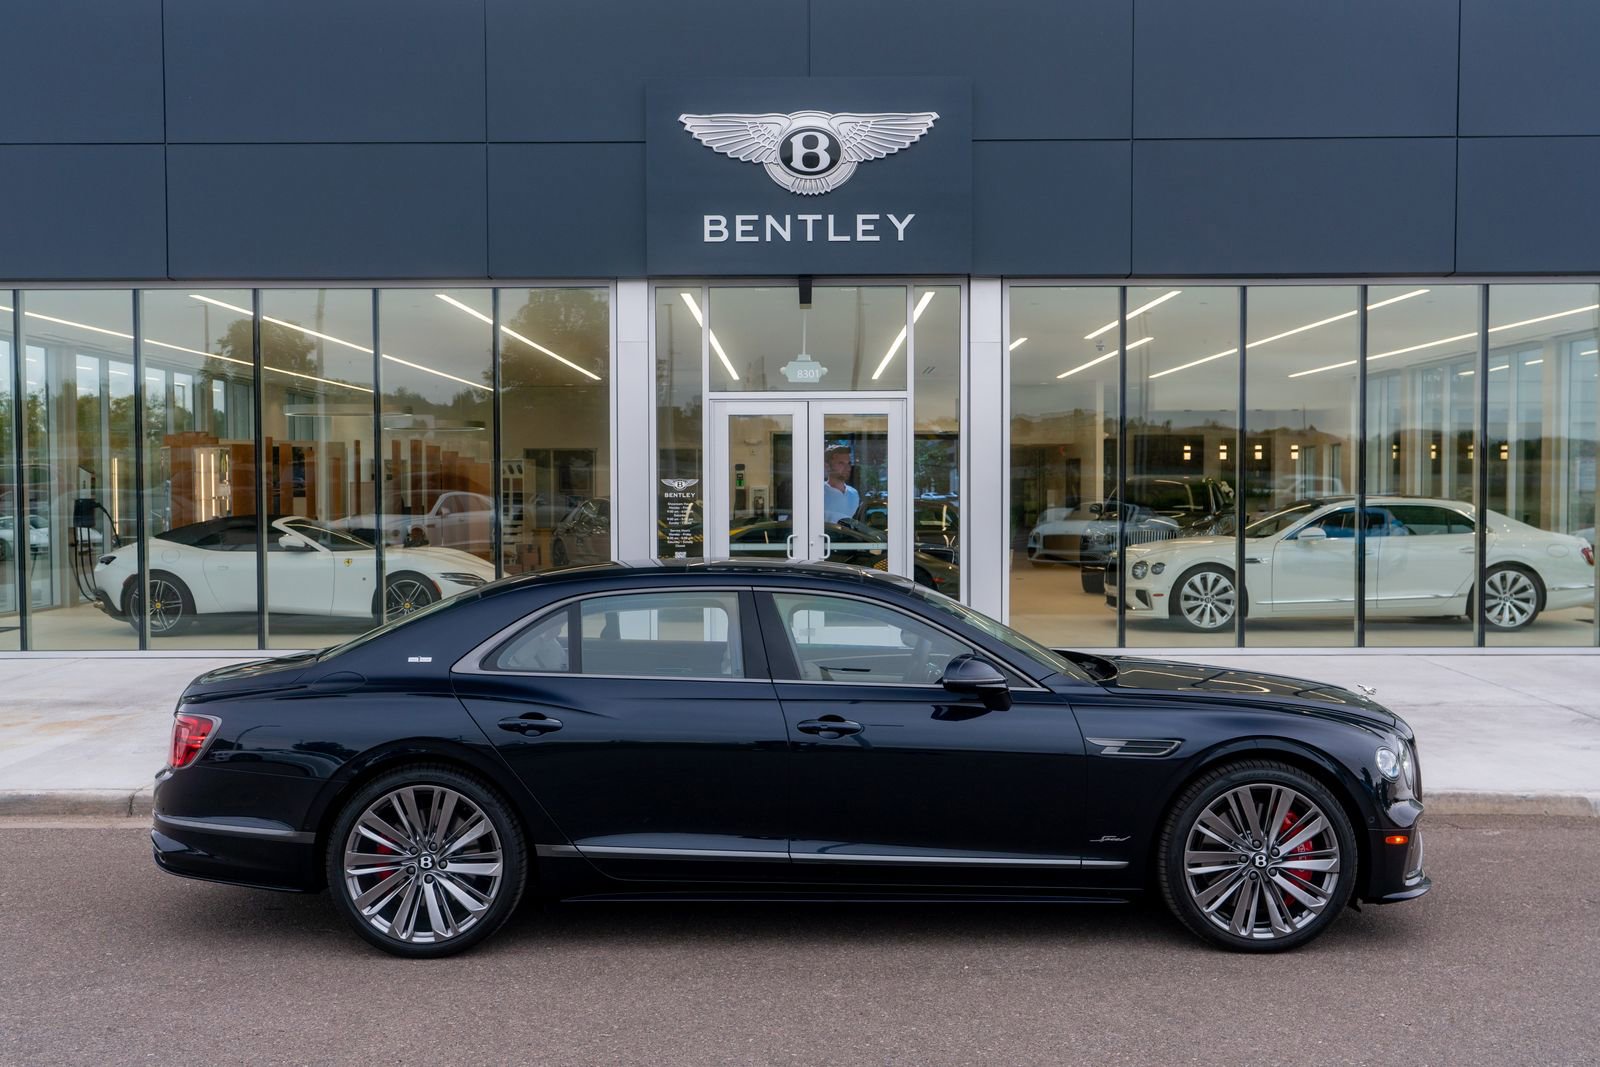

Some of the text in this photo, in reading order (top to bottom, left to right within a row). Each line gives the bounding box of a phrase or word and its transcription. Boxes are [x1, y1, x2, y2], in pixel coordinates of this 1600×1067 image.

[789, 131, 831, 172] B
[703, 213, 916, 243] BENTLEY
[420, 856, 432, 868] B
[1254, 854, 1267, 868] B
